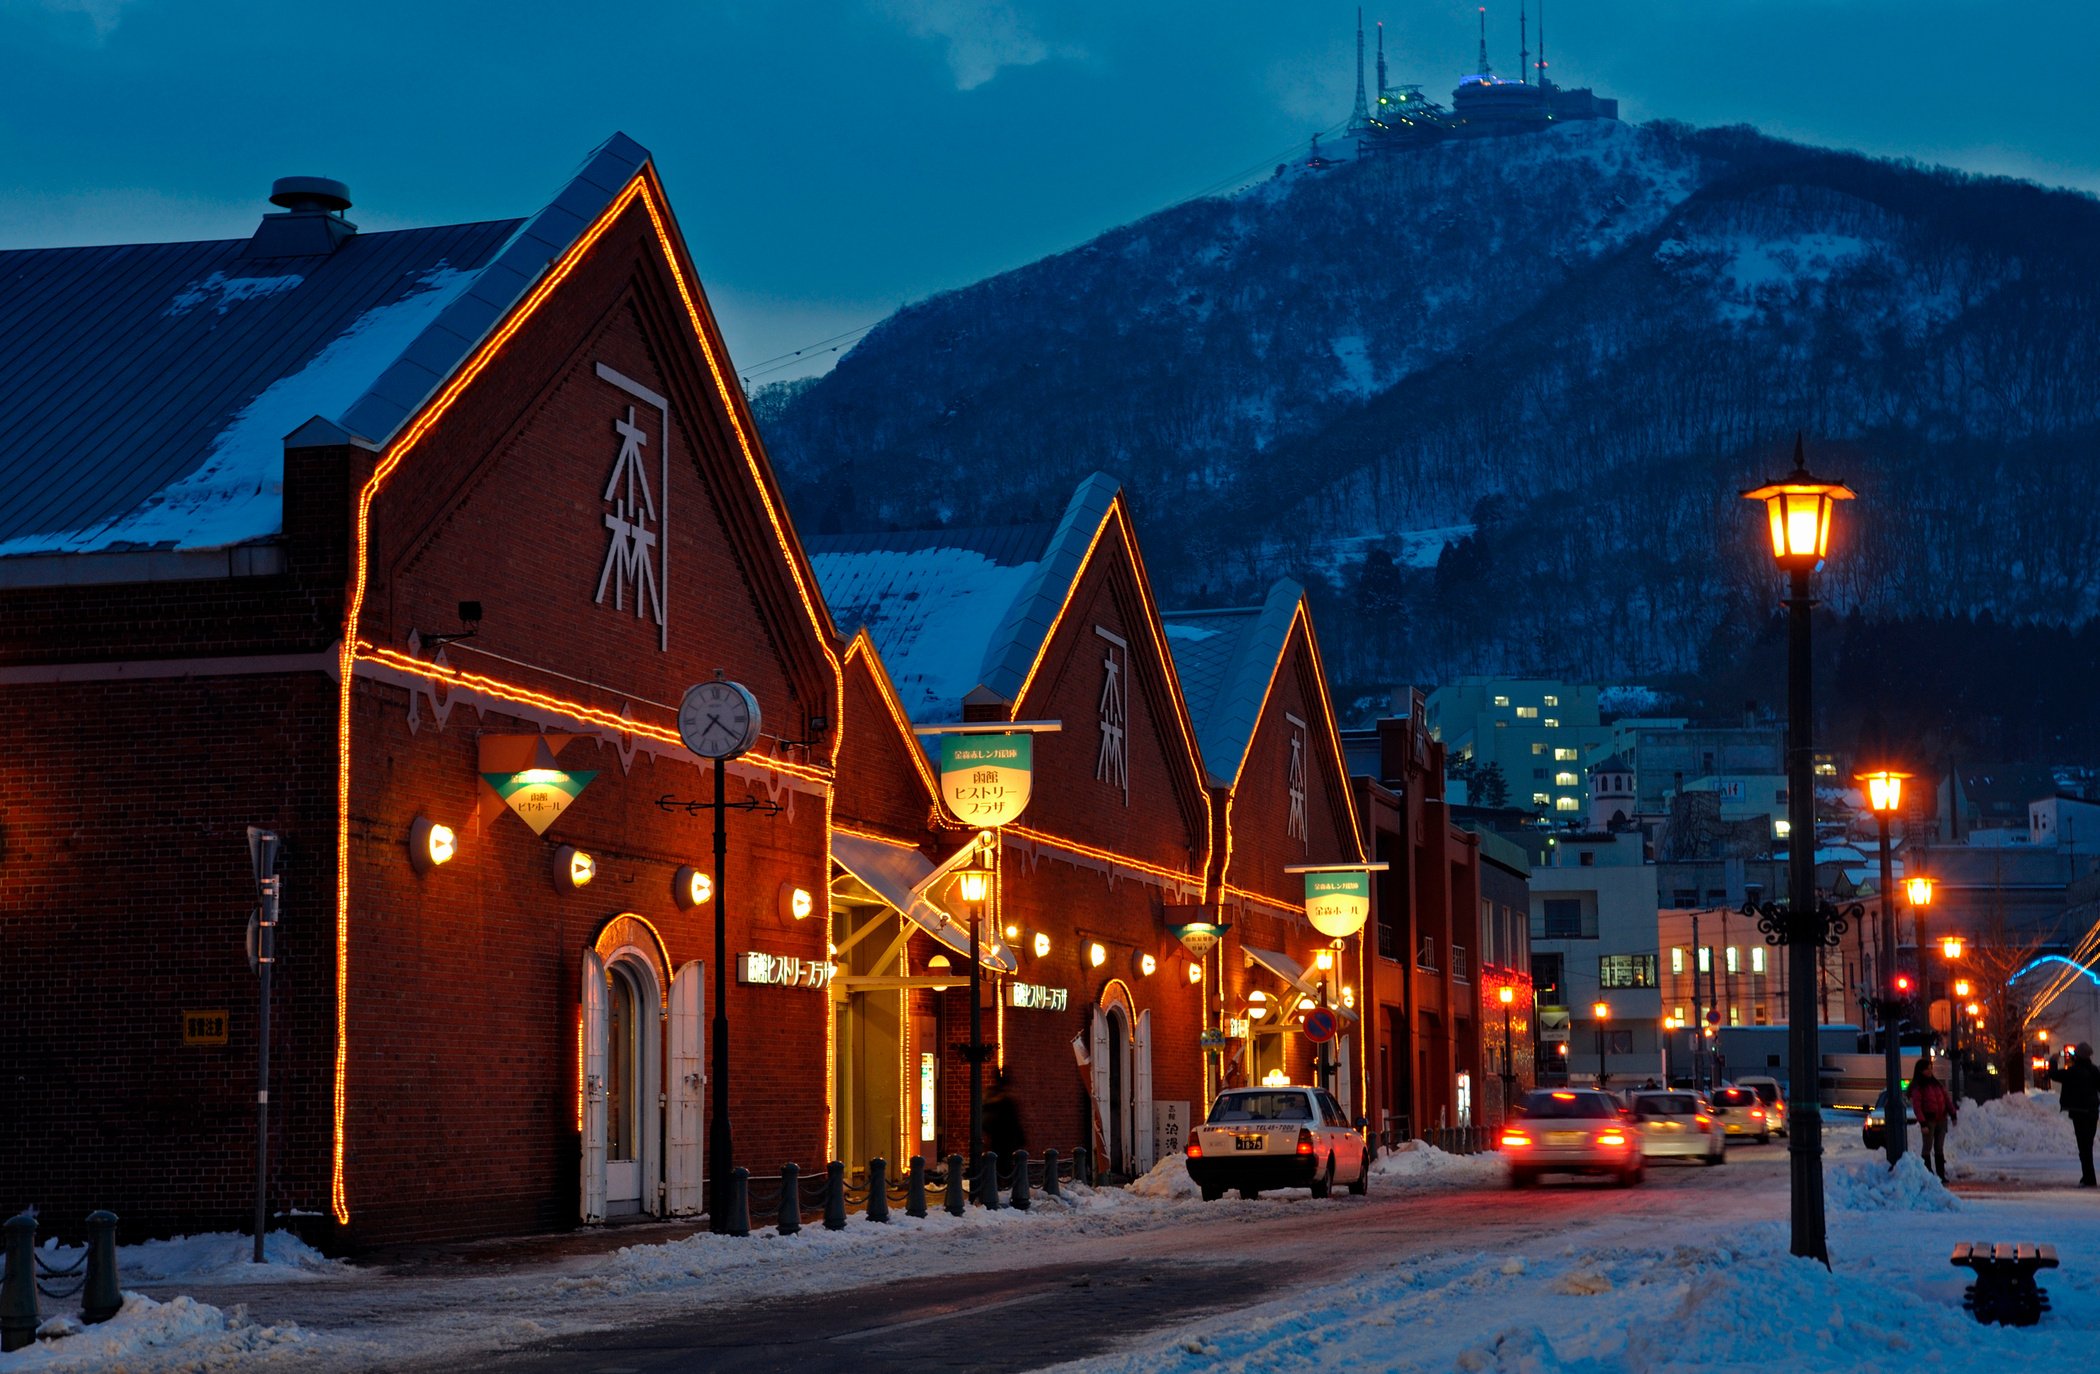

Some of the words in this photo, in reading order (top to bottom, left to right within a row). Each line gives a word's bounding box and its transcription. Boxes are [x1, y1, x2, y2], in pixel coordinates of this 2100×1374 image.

[973, 771, 998, 784] 函館
[955, 786, 1017, 800] ヒストリー
[967, 801, 1006, 814] プラザ
